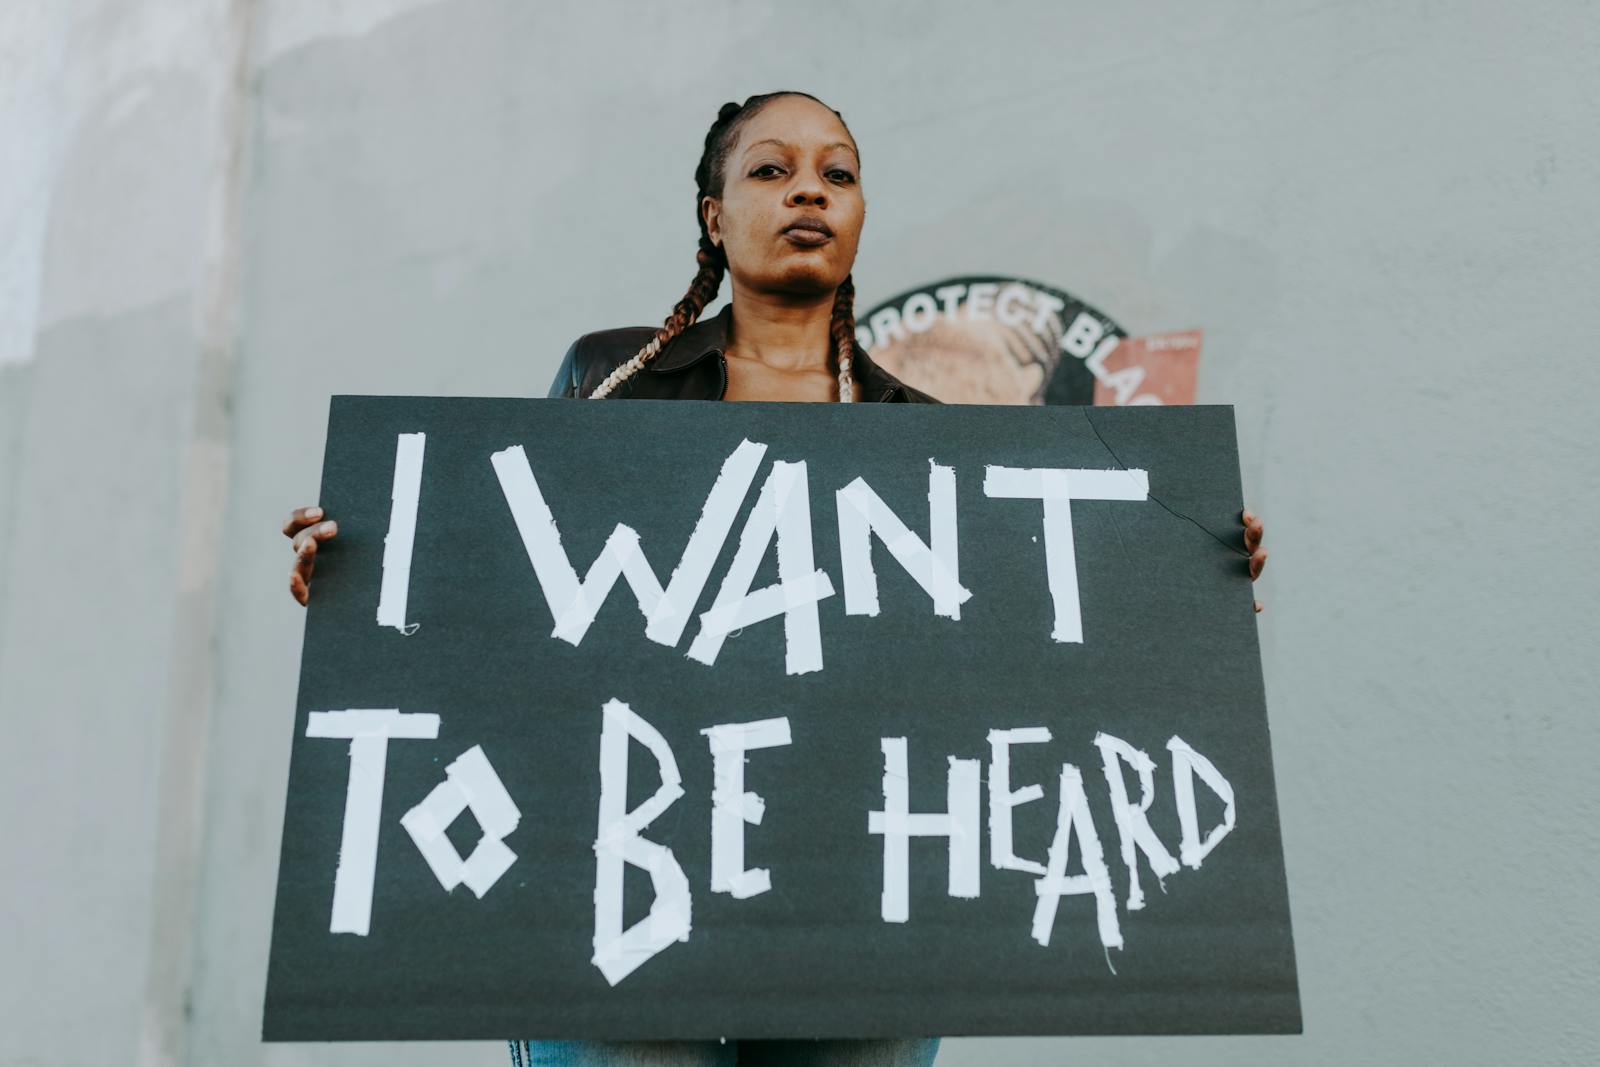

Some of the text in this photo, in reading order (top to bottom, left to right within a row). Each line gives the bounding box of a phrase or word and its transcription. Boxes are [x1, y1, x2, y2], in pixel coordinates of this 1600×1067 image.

[377, 432, 1149, 675] I WANT
[306, 698, 1235, 986] TO BE HEARD
